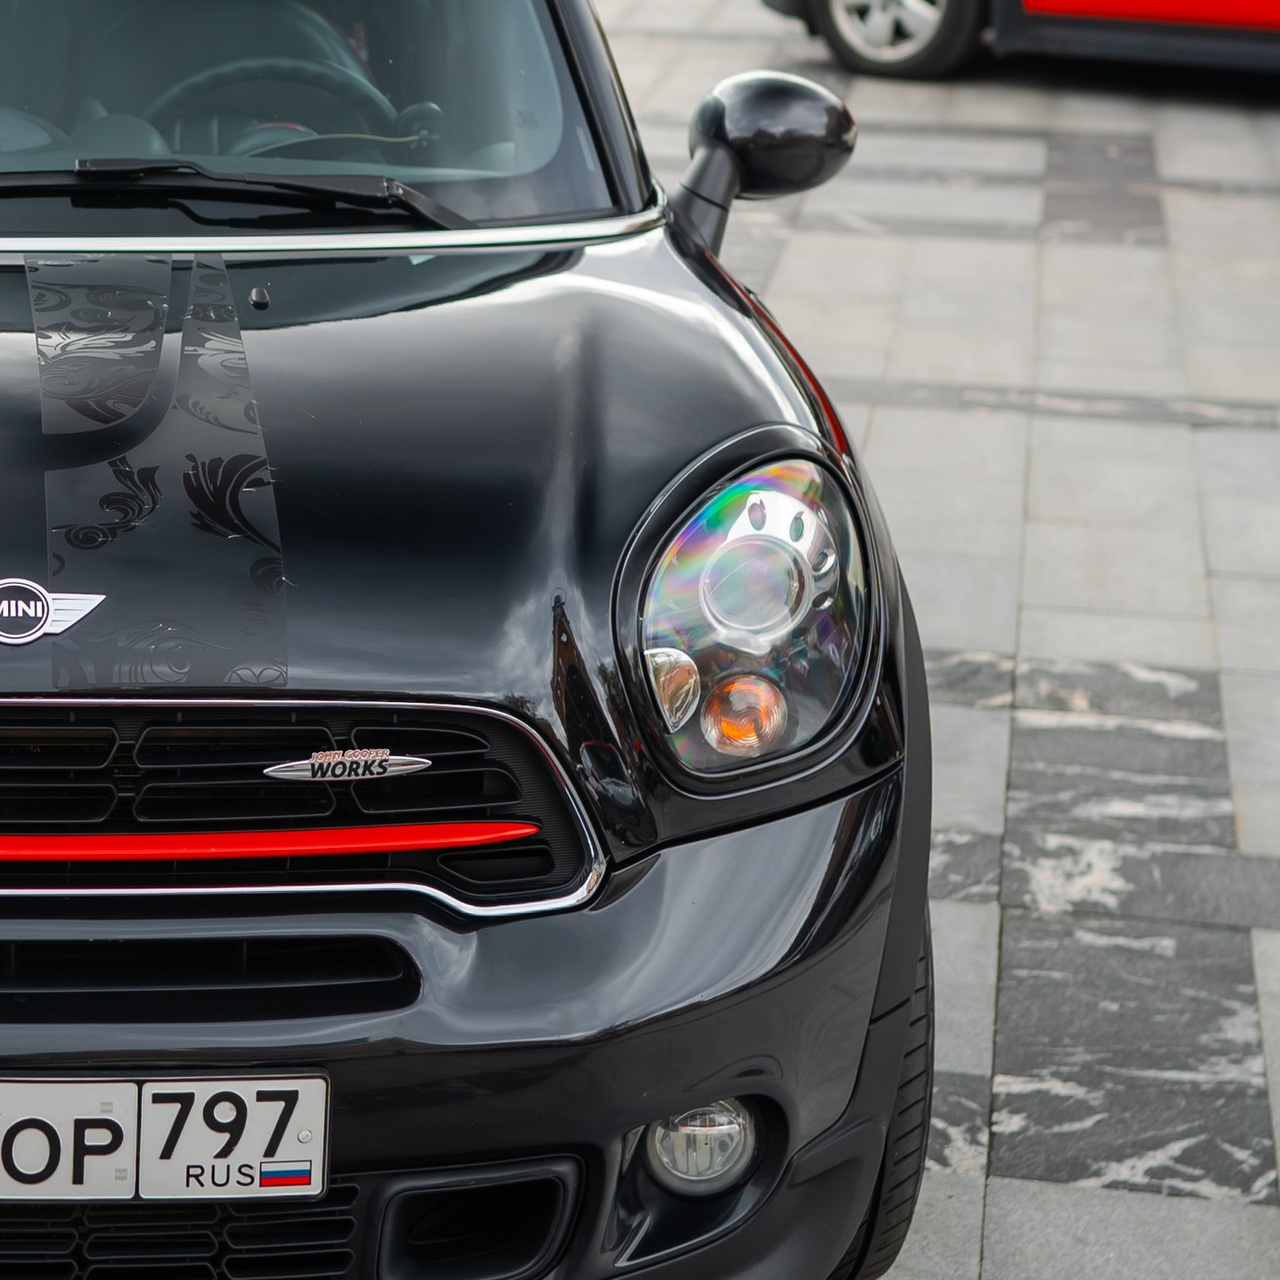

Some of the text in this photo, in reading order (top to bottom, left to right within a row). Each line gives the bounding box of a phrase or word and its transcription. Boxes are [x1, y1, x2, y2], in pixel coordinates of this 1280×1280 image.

[311, 748, 390, 763] JOHN COOPER
[310, 759, 390, 778] WORKS
[151, 1089, 300, 1160] 797
[185, 1163, 255, 1188] RUS
